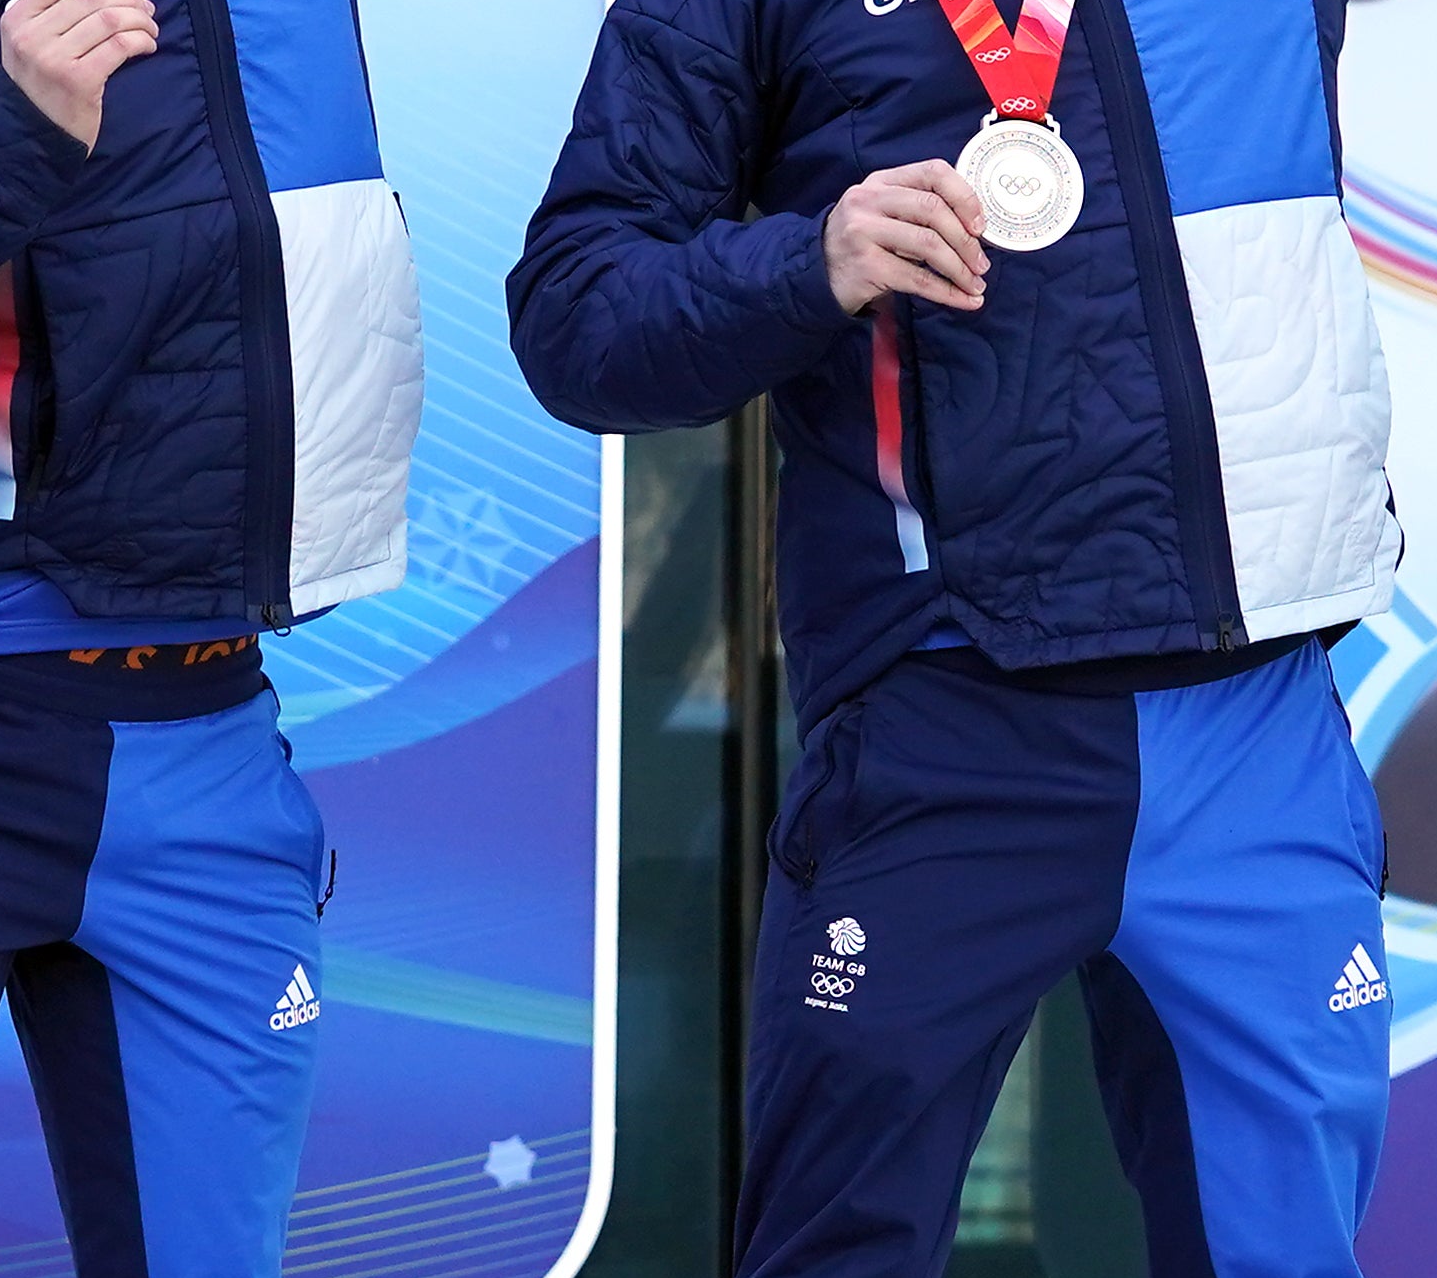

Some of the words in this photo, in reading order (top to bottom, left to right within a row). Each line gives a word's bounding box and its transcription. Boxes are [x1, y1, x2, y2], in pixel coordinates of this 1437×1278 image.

[812, 954, 845, 972] TEAM
[846, 962, 866, 977] GB
[1328, 980, 1388, 1013] adidas
[269, 1000, 321, 1031] adidas
